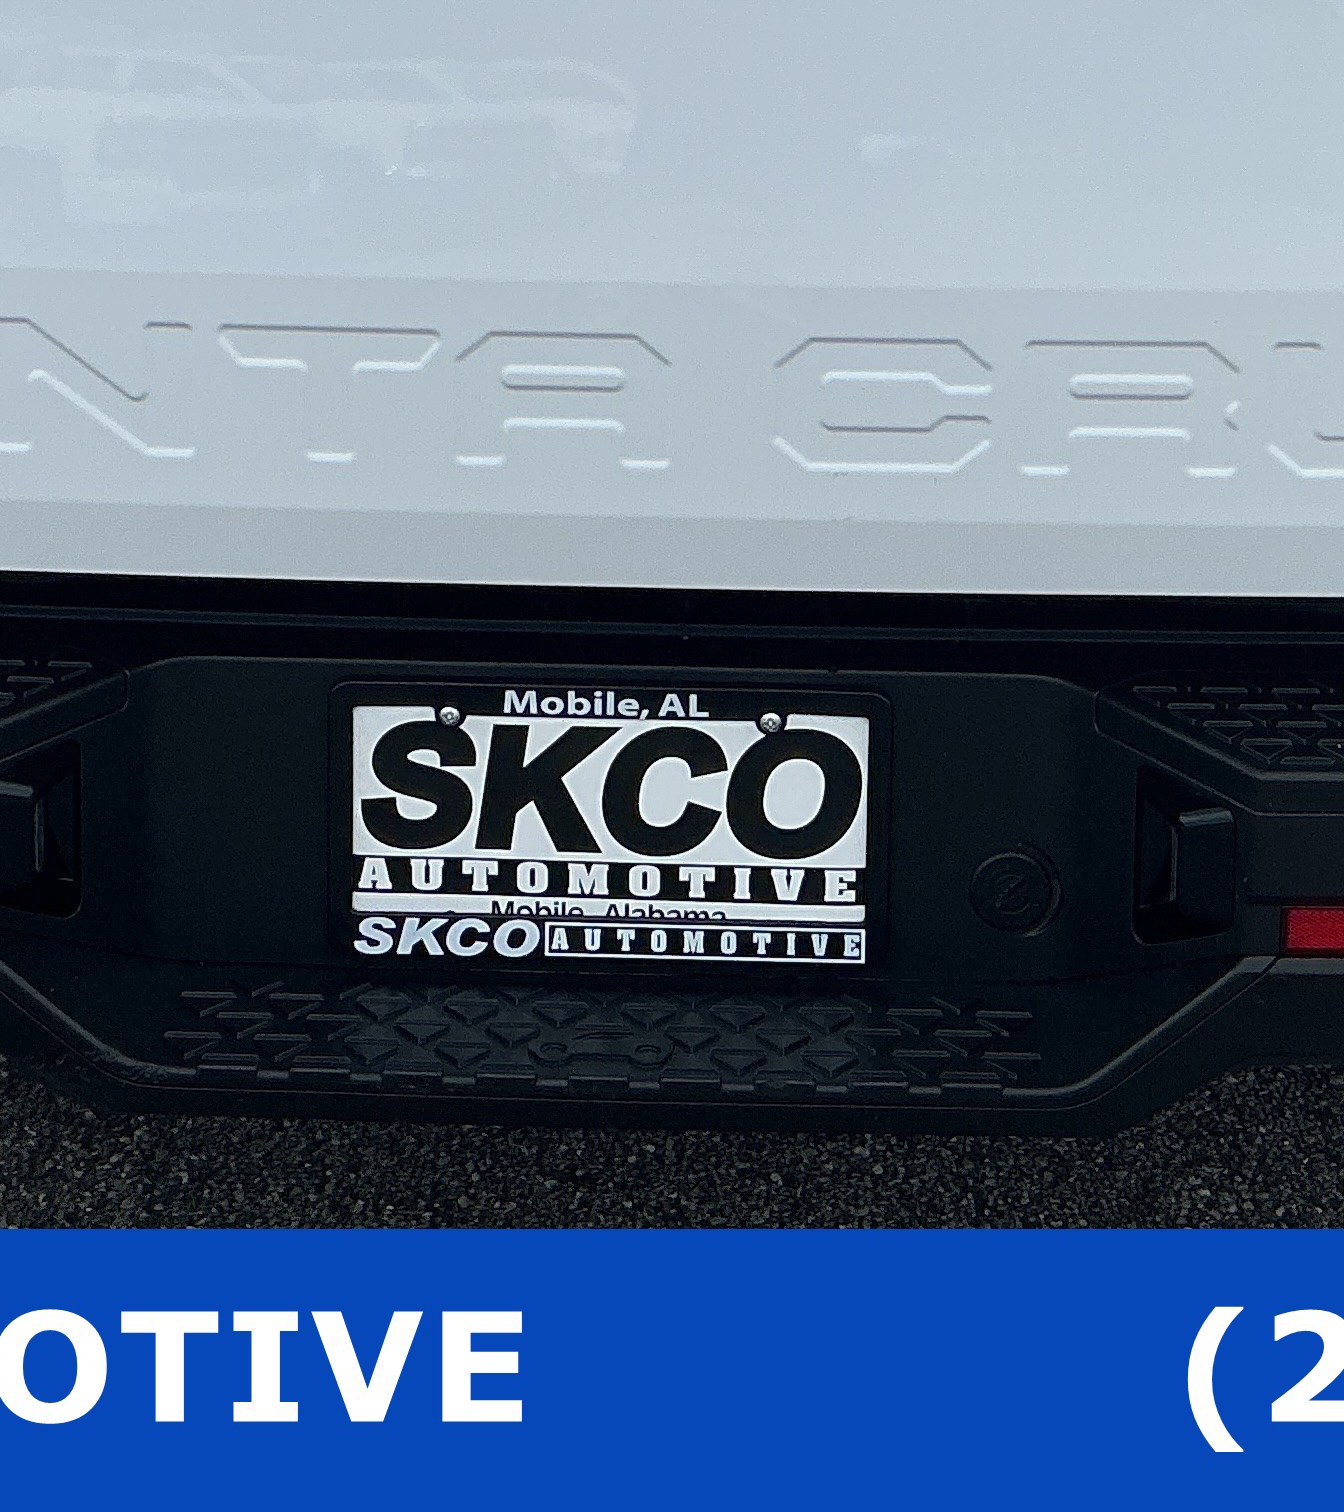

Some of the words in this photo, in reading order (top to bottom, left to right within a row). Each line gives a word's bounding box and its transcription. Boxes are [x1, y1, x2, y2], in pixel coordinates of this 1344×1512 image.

[503, 689, 650, 720] Mobile,
[658, 693, 709, 718] AL
[360, 719, 863, 860] SKCO
[358, 857, 856, 902] AUTOMOTIVE
[354, 917, 541, 958] SKCO
[550, 927, 860, 957] AUTOMOTIVE
